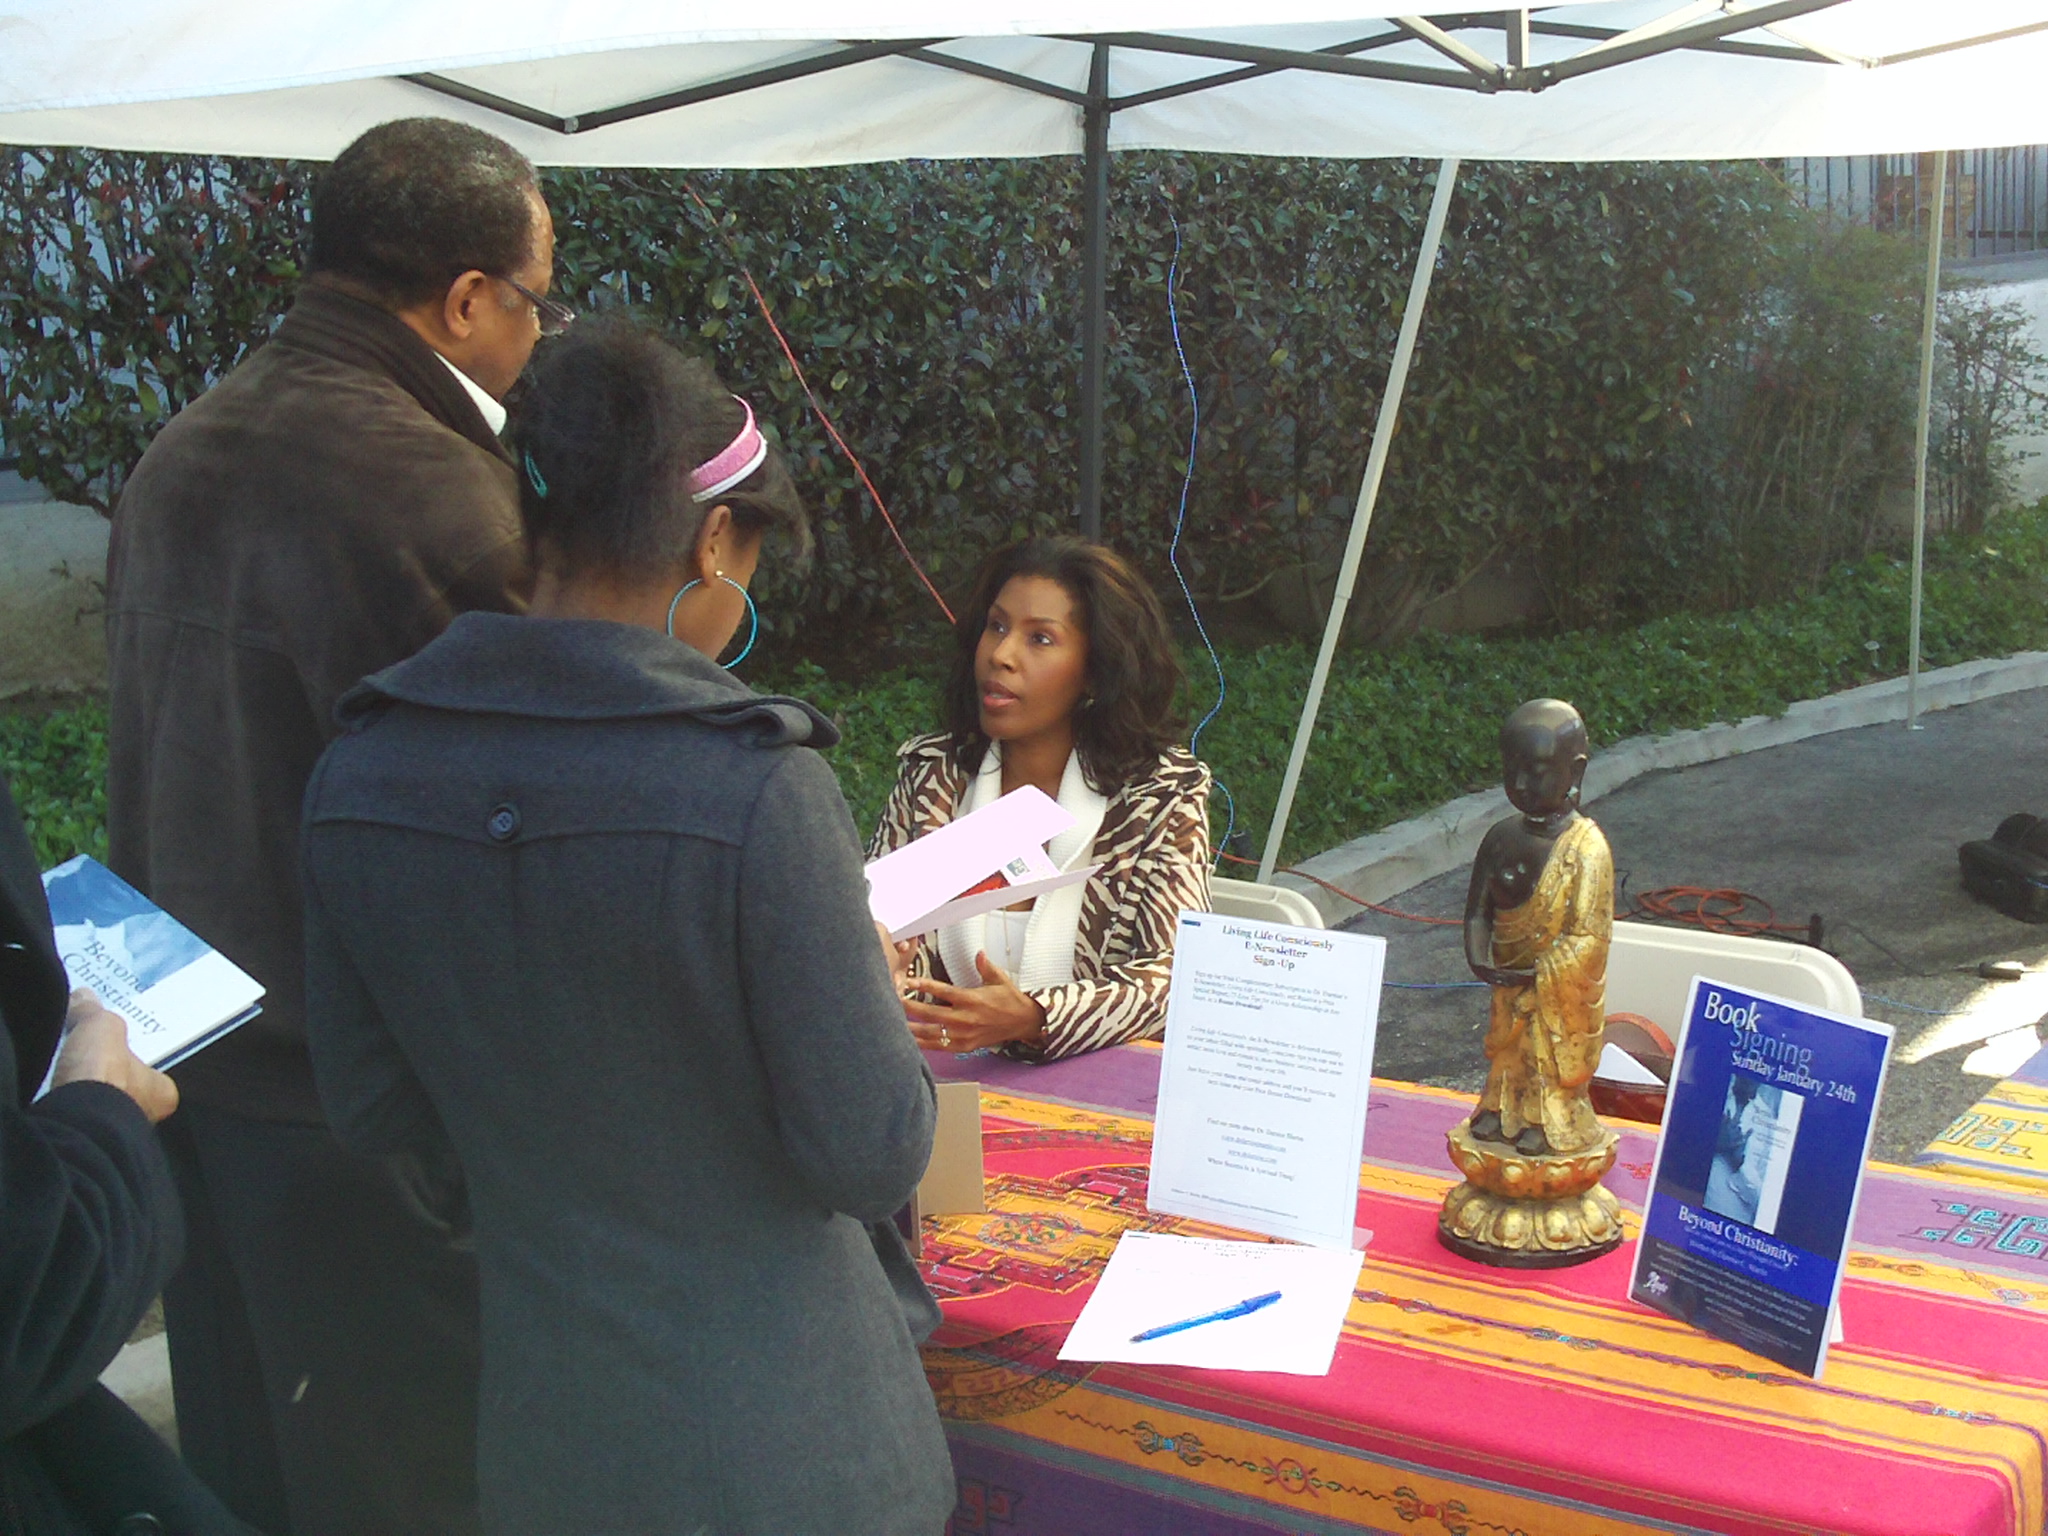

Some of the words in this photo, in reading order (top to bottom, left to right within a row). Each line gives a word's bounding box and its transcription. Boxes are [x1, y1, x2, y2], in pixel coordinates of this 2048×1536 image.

[1222, 925, 1252, 940] Living
[1254, 928, 1273, 941] Life
[1275, 933, 1335, 951] Consciously
[1245, 941, 1309, 958] E-Newsletter
[84, 941, 156, 994] Beyond
[1253, 954, 1275, 967] Sign
[63, 953, 167, 1034] Christianity
[1704, 991, 1762, 1033] Book
[1729, 1023, 1813, 1078] Signing
[1731, 1050, 1775, 1081] Sunday
[1775, 1065, 1824, 1097] January
[1825, 1080, 1857, 1104] 24th
[1678, 1205, 1723, 1235] Beyond
